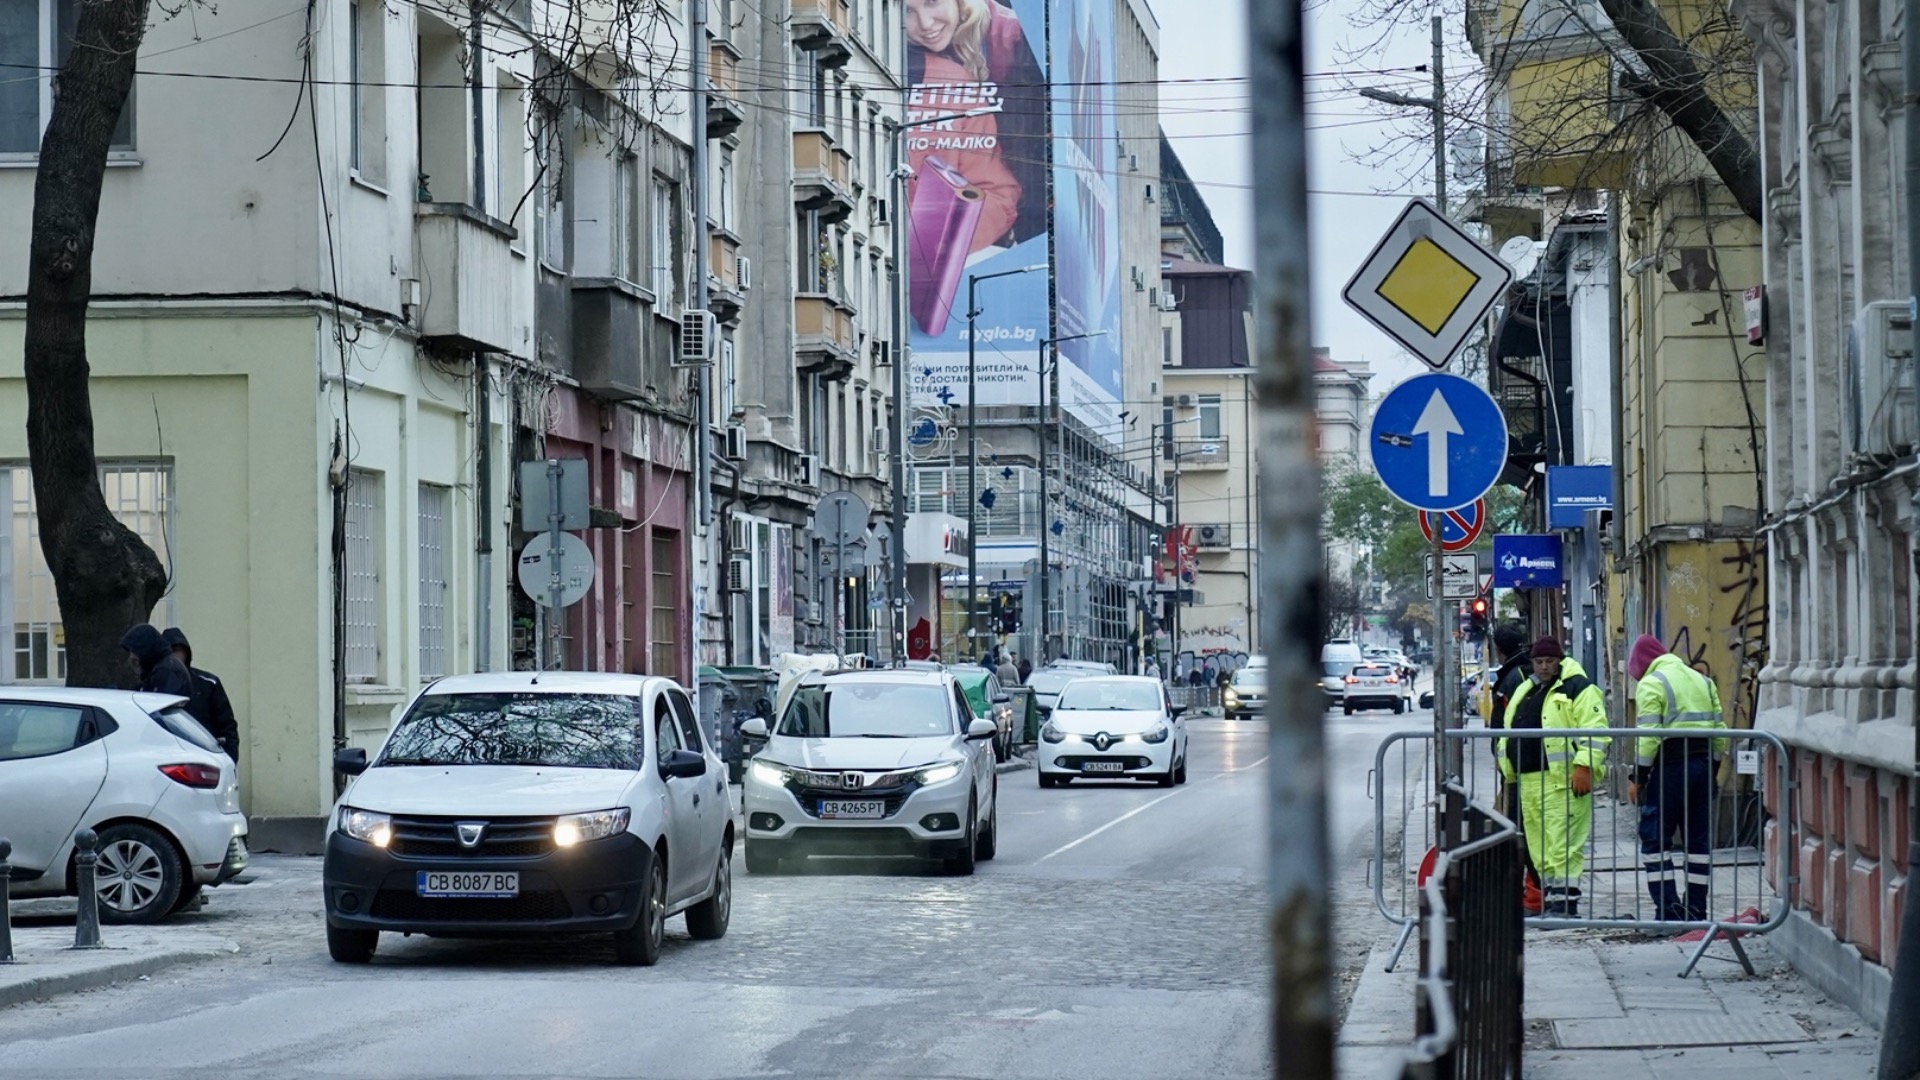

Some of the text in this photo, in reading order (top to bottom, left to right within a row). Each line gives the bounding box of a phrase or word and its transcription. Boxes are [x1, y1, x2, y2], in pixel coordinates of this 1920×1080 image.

[905, 82, 1004, 107] ETHER,
[907, 136, 997, 150] ПО-МАЛКО
[959, 326, 1037, 342] myglo.bg
[945, 365, 1013, 373] ПОТРБИТЕЛИ
[1015, 364, 1030, 373] НА
[929, 375, 969, 384] ДОСТАВ
[824, 802, 882, 814] CB 4265 PT
[428, 874, 449, 890] CB
[453, 874, 491, 890] 8087
[494, 874, 516, 890] BC
